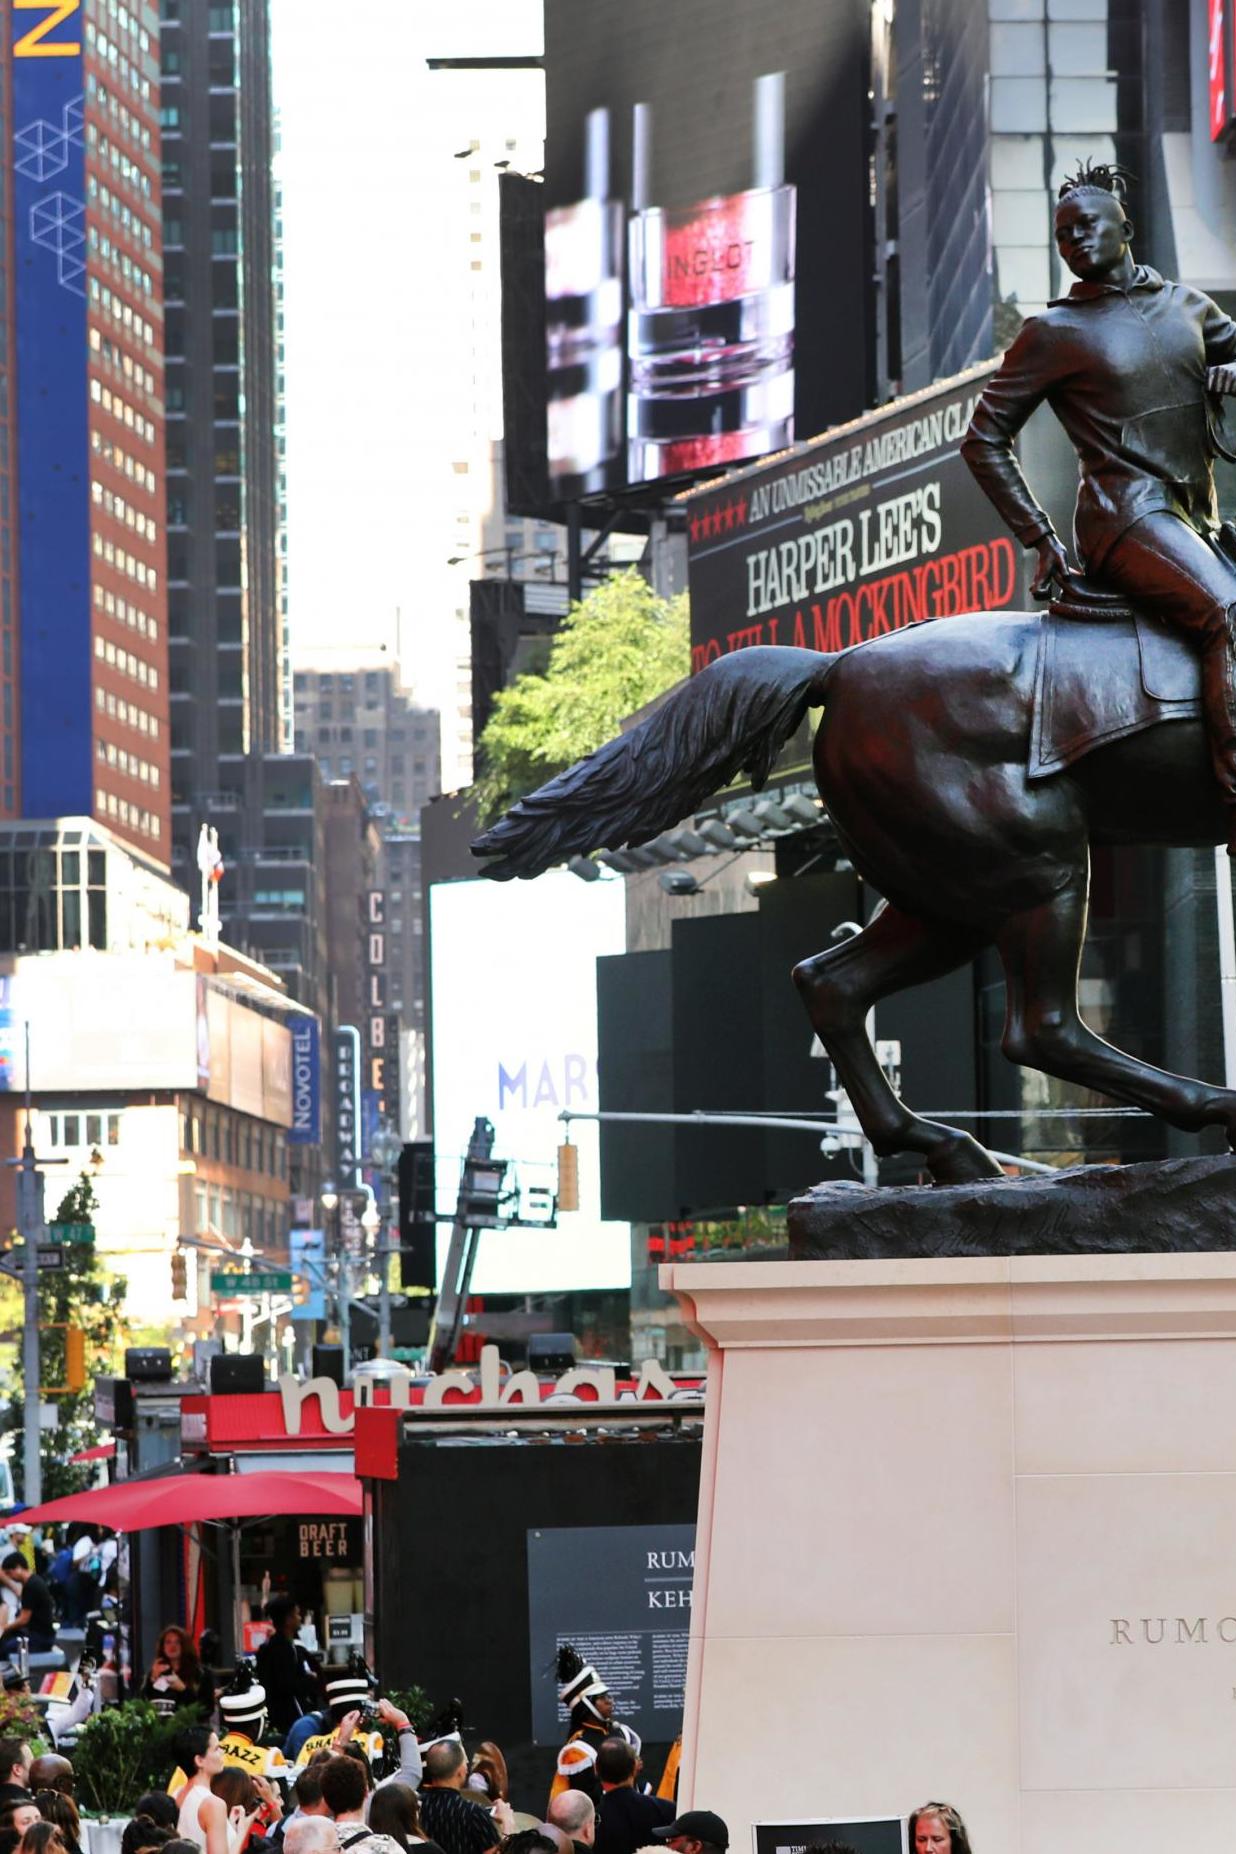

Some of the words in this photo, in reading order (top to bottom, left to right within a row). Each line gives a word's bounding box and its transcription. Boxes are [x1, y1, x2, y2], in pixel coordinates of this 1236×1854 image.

[748, 487, 771, 523] AN
[772, 444, 863, 515] UNMISSABLE
[863, 409, 944, 476] AMERICAN
[746, 517, 856, 617] HARPER
[859, 482, 942, 577] LEE'S
[811, 537, 1016, 653] MOCKINGBIRD
[369, 892, 385, 1108] COLBE
[294, 1028, 311, 1129] NOVOTEL
[299, 1523, 347, 1541] DRAFT
[300, 1541, 347, 1557] BEER
